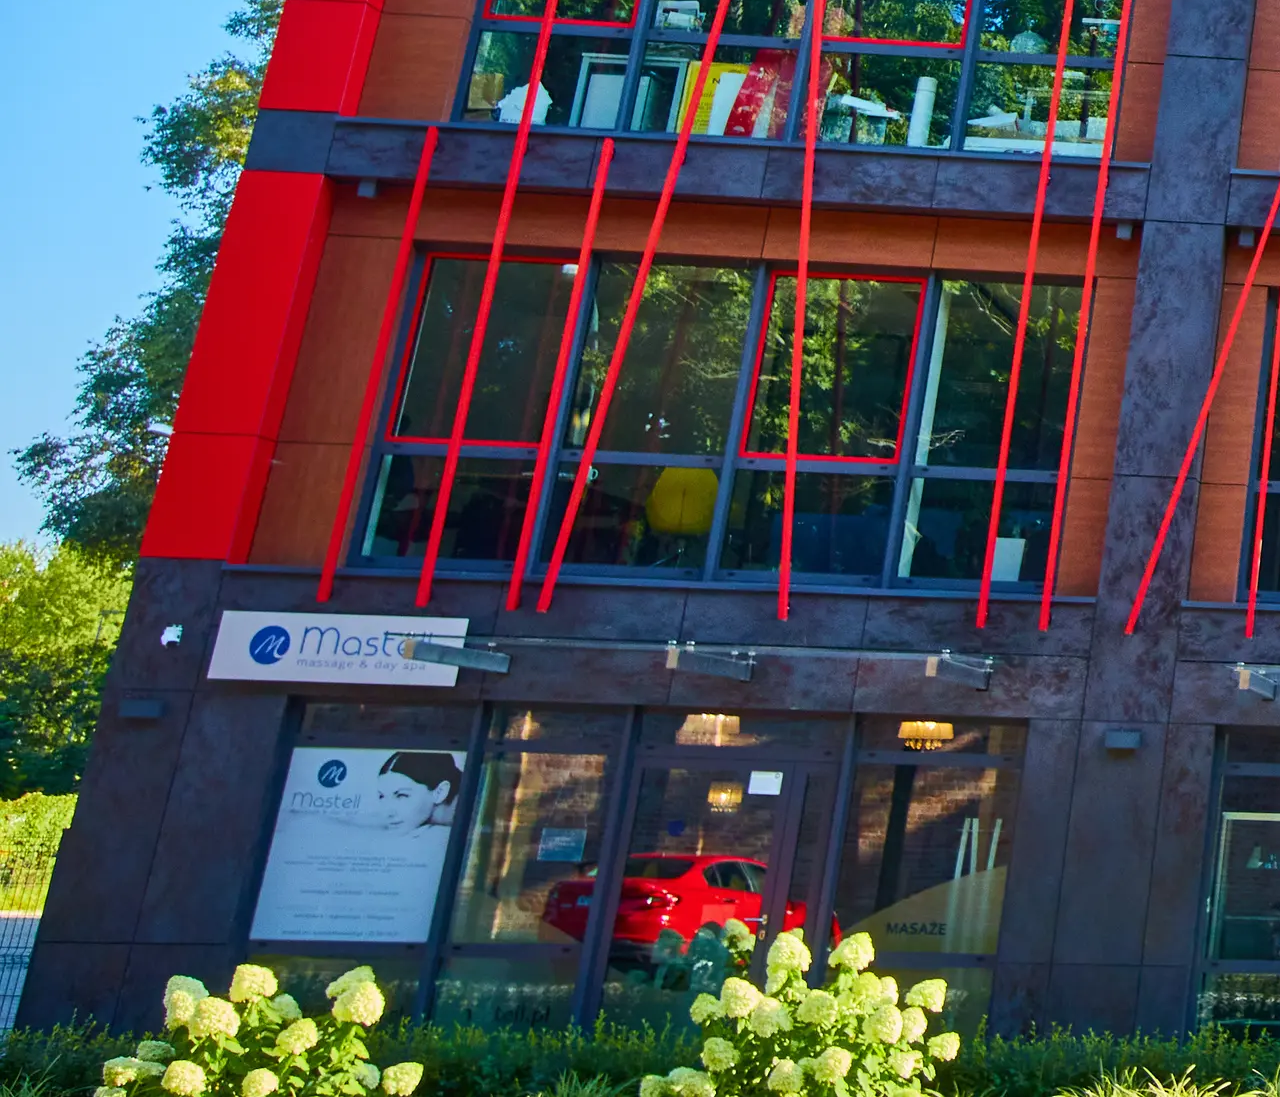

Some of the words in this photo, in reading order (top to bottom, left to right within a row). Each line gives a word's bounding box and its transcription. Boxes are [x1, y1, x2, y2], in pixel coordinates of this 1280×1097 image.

[296, 658, 354, 669] massage
[359, 657, 369, 669] &
[374, 658, 399, 671] day
[402, 661, 426, 671] spa
[886, 919, 947, 936] MASAŻE
